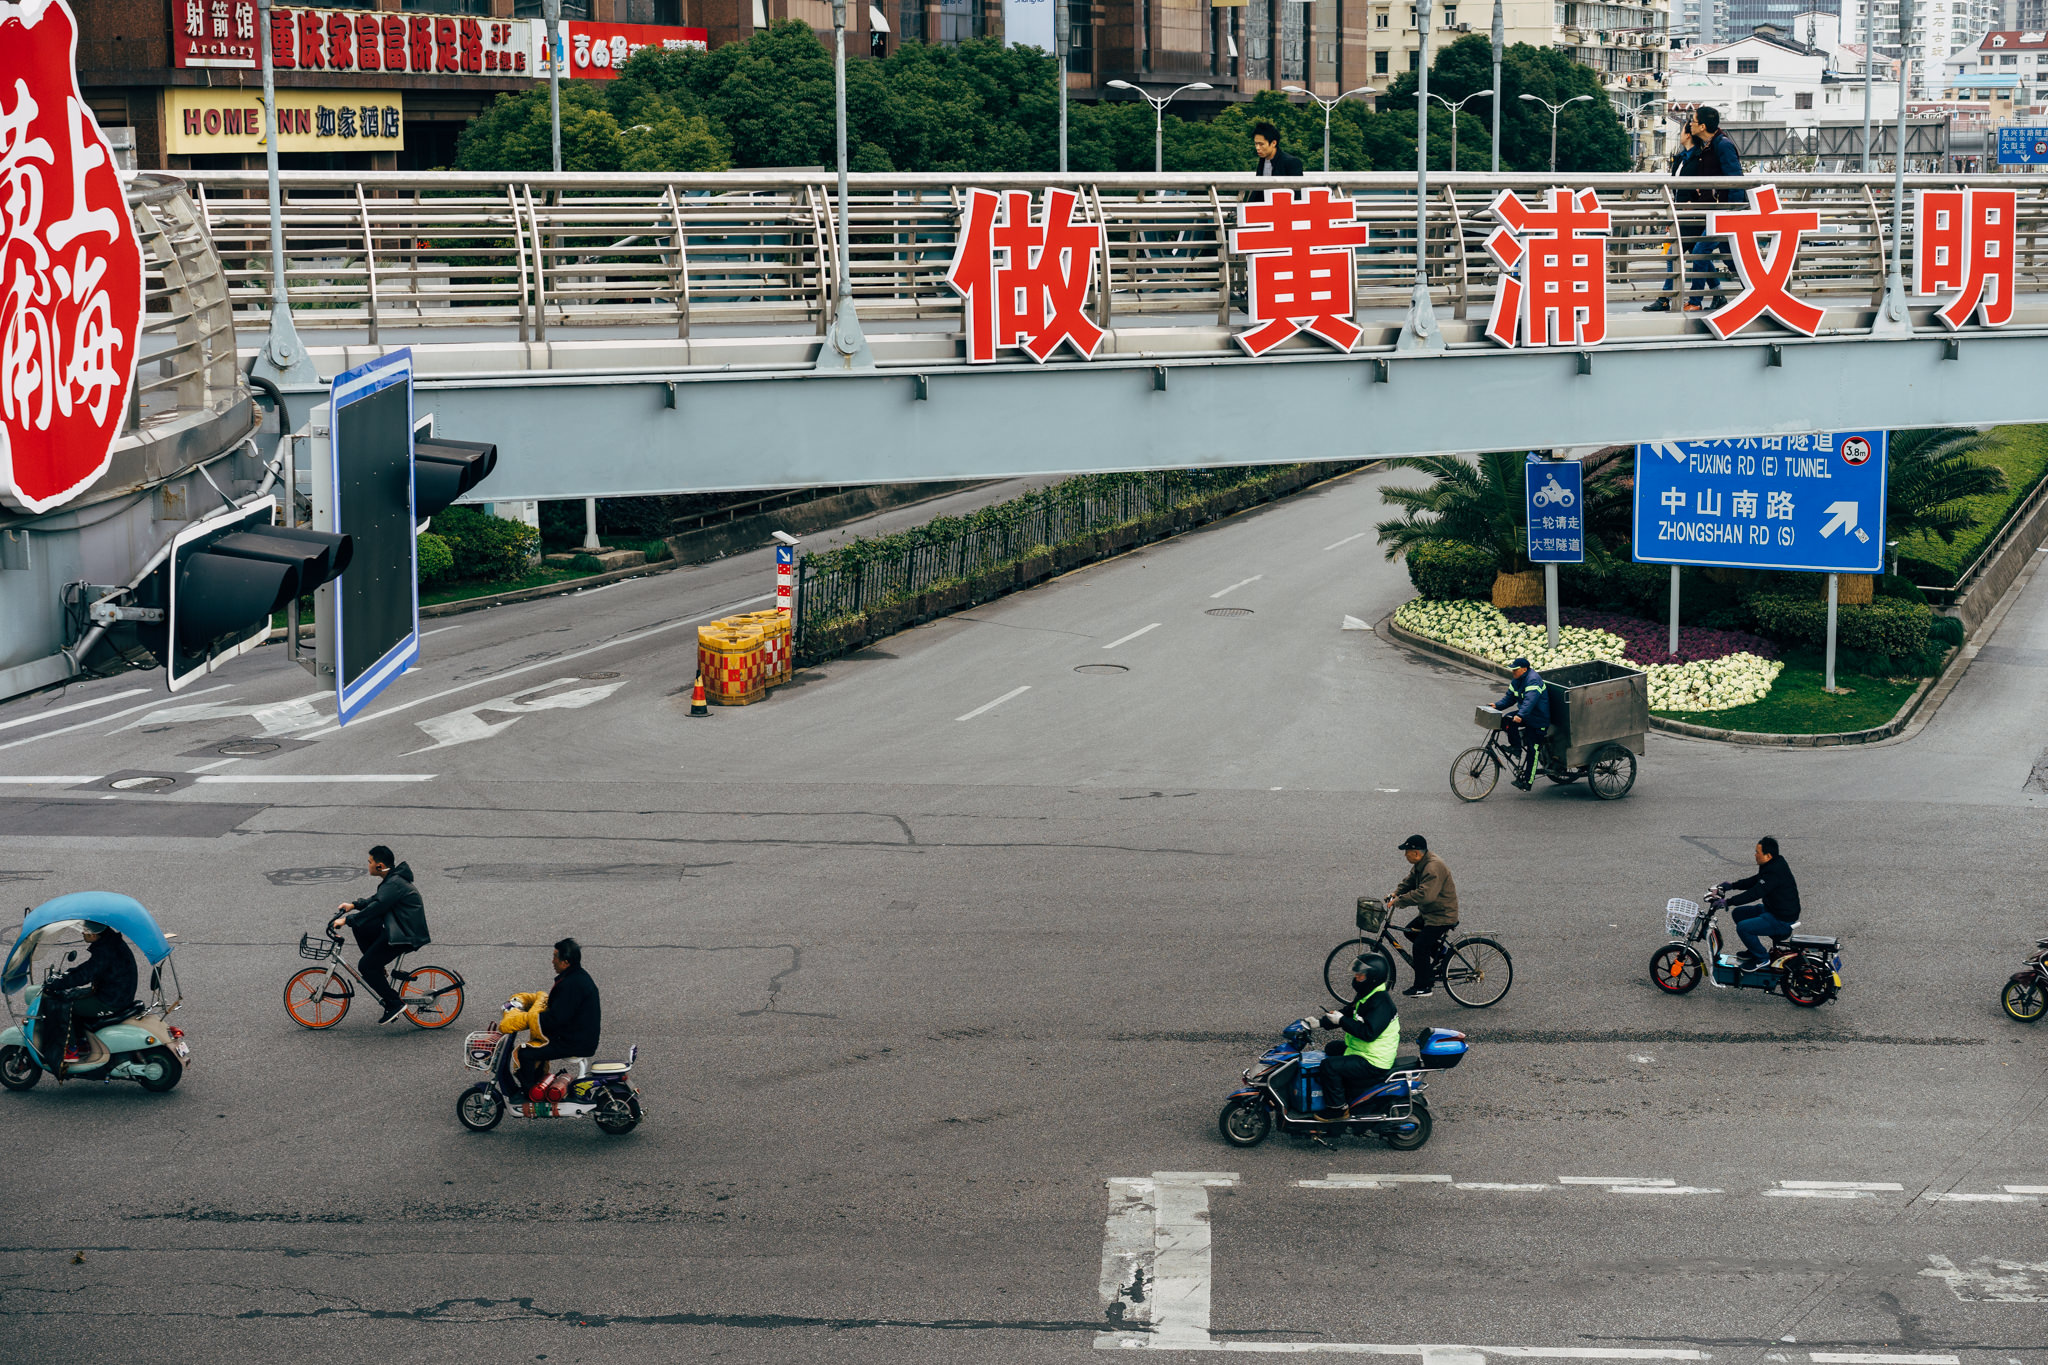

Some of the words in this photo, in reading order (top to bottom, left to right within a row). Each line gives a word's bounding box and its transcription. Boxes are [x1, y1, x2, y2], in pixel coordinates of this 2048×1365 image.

[184, 0, 254, 38] 射箭馆
[271, 9, 482, 73] 重庆家富富侨足浴
[490, 24, 511, 45] 3F
[189, 41, 254, 58] Archery
[485, 50, 526, 71] 旗舰店
[184, 108, 259, 135] HOME
[277, 108, 311, 134] NN
[315, 105, 400, 138] 如家酒店
[46, 95, 123, 428] 上海
[947, 184, 2017, 365] 做黄浦文明
[1846, 445, 1867, 458] 3.8m
[1689, 453, 1732, 475] FUXING
[1737, 455, 1755, 476] RD
[1761, 456, 1778, 477] (E)
[1785, 456, 1832, 479] TUNNEL
[1660, 486, 1796, 521] 中山南路
[1531, 516, 1580, 530] 二轮请走
[1658, 520, 1743, 544] ZHONGSHAN
[1749, 525, 1770, 546] RD
[1777, 526, 1796, 547] (S)
[1531, 538, 1580, 552] 大型隧道
